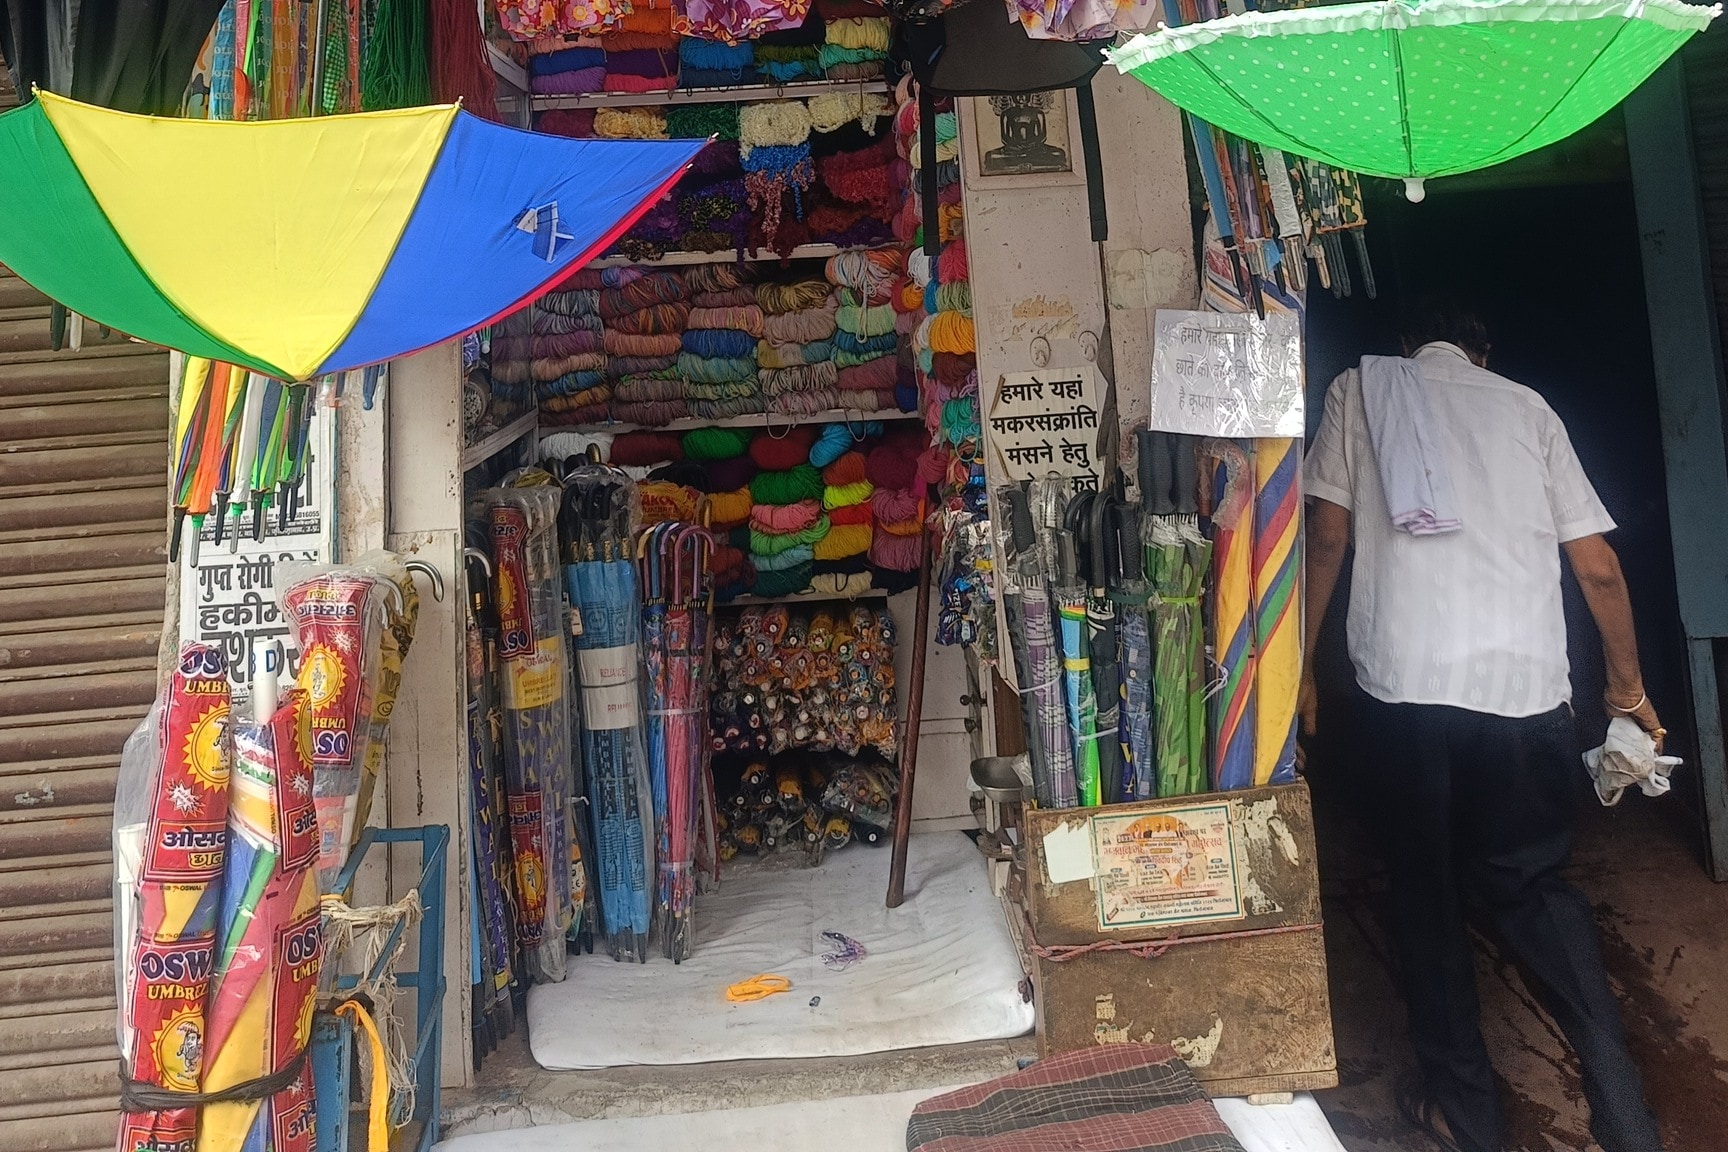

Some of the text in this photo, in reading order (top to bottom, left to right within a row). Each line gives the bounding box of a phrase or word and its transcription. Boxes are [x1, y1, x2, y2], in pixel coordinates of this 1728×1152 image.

[1001, 374, 1083, 404] हमारे यहां
[990, 405, 1097, 434] मकरसंक्रांति
[1059, 437, 1090, 468] हेतु
[199, 554, 275, 602] गुप्त रोगी
